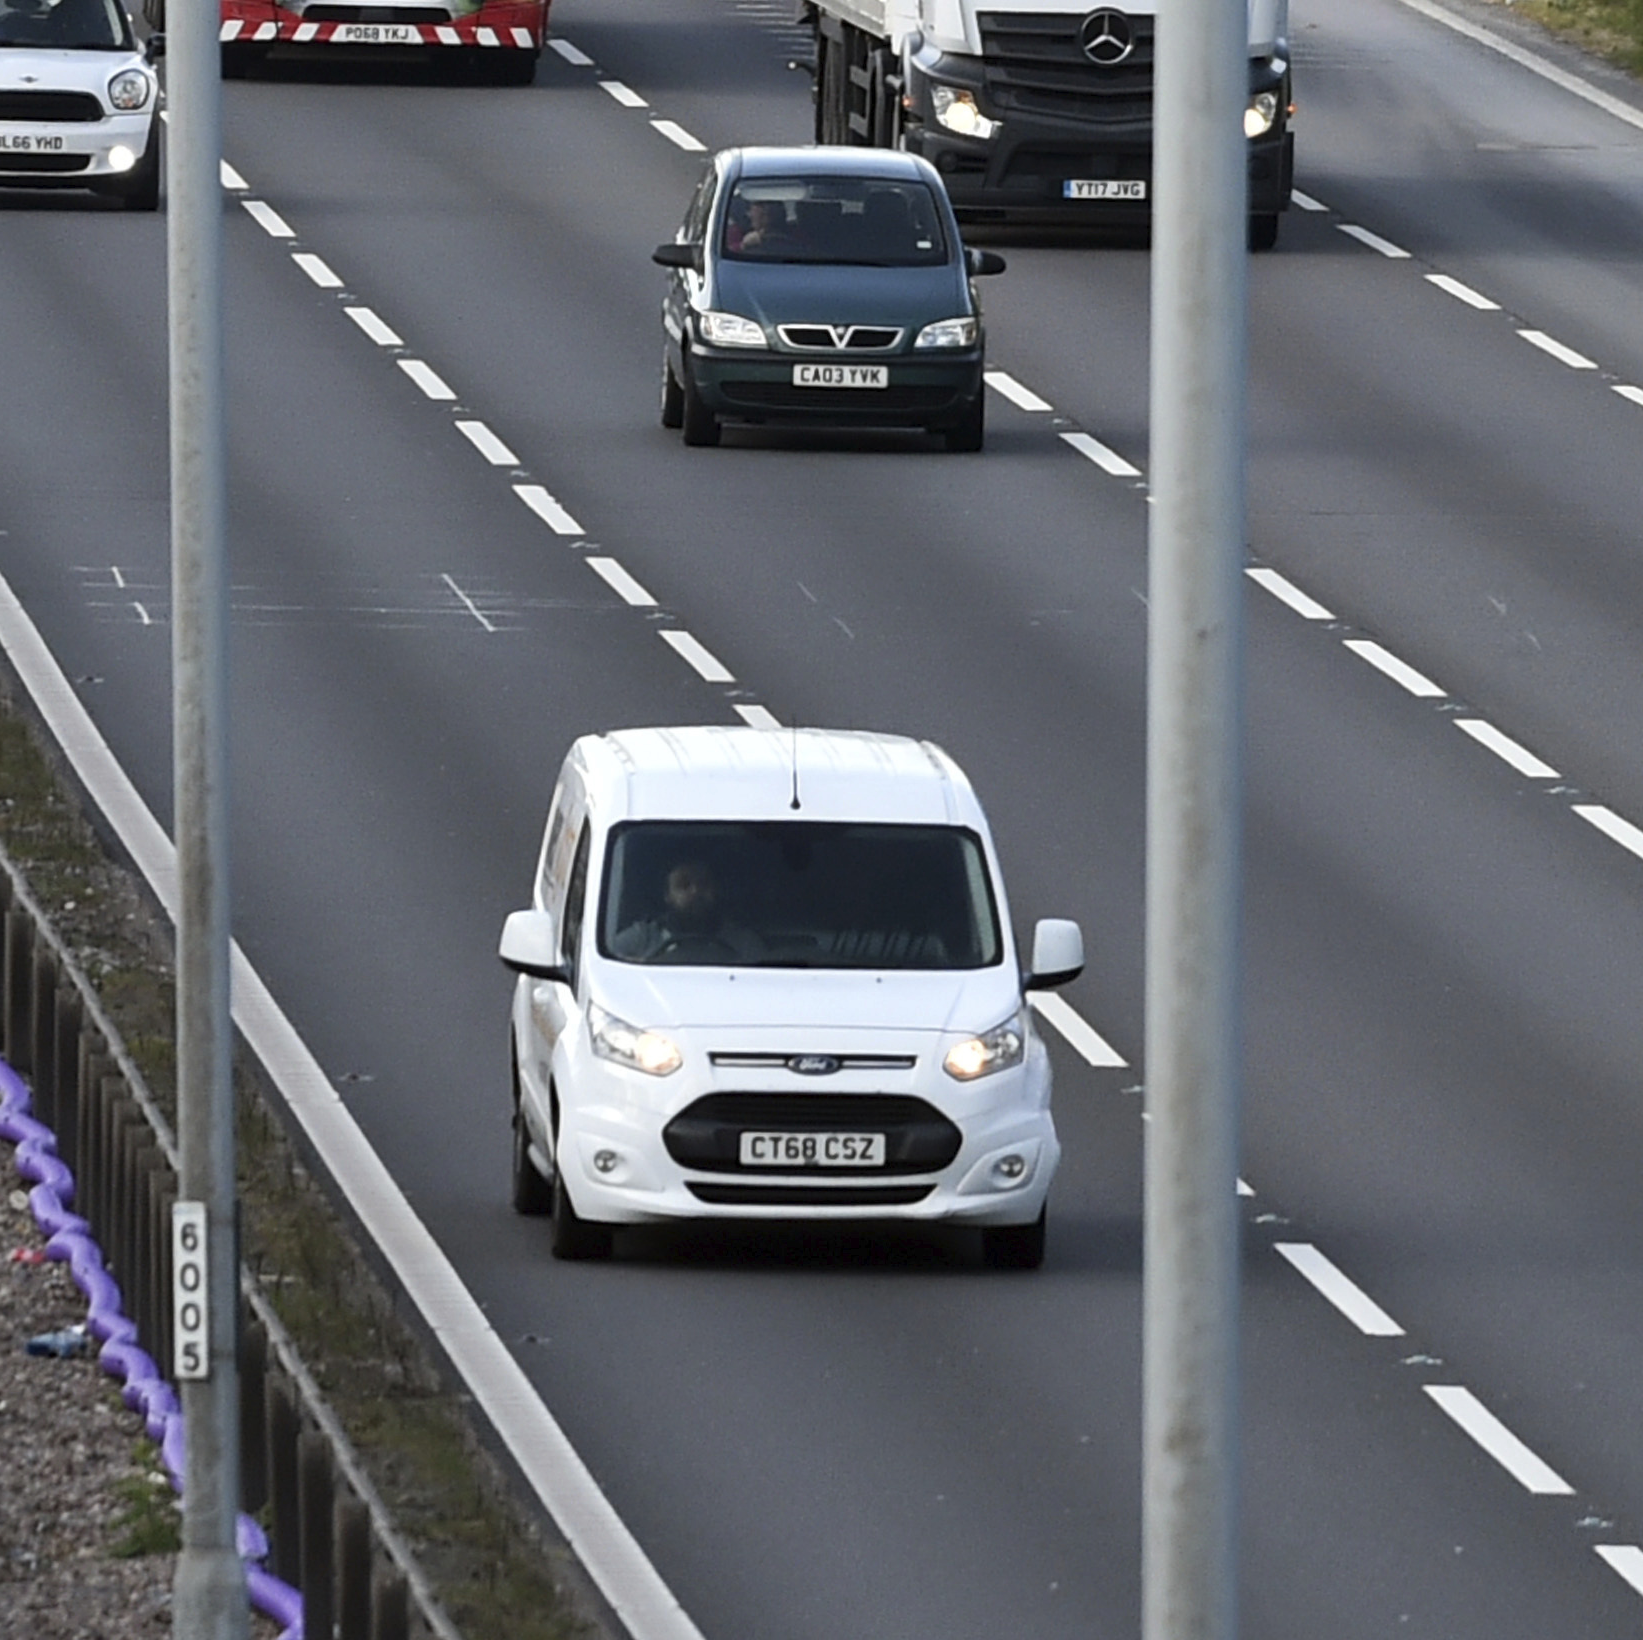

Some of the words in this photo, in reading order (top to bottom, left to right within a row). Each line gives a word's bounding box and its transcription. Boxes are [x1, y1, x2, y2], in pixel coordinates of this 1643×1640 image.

[1075, 181, 1108, 196] YT17
[1111, 181, 1141, 196] JVG
[800, 366, 844, 384] CA03
[848, 367, 881, 384] YVK
[751, 1136, 817, 1160] CT68
[823, 1136, 874, 1160] CSZ
[180, 1222, 201, 1373] 6005
